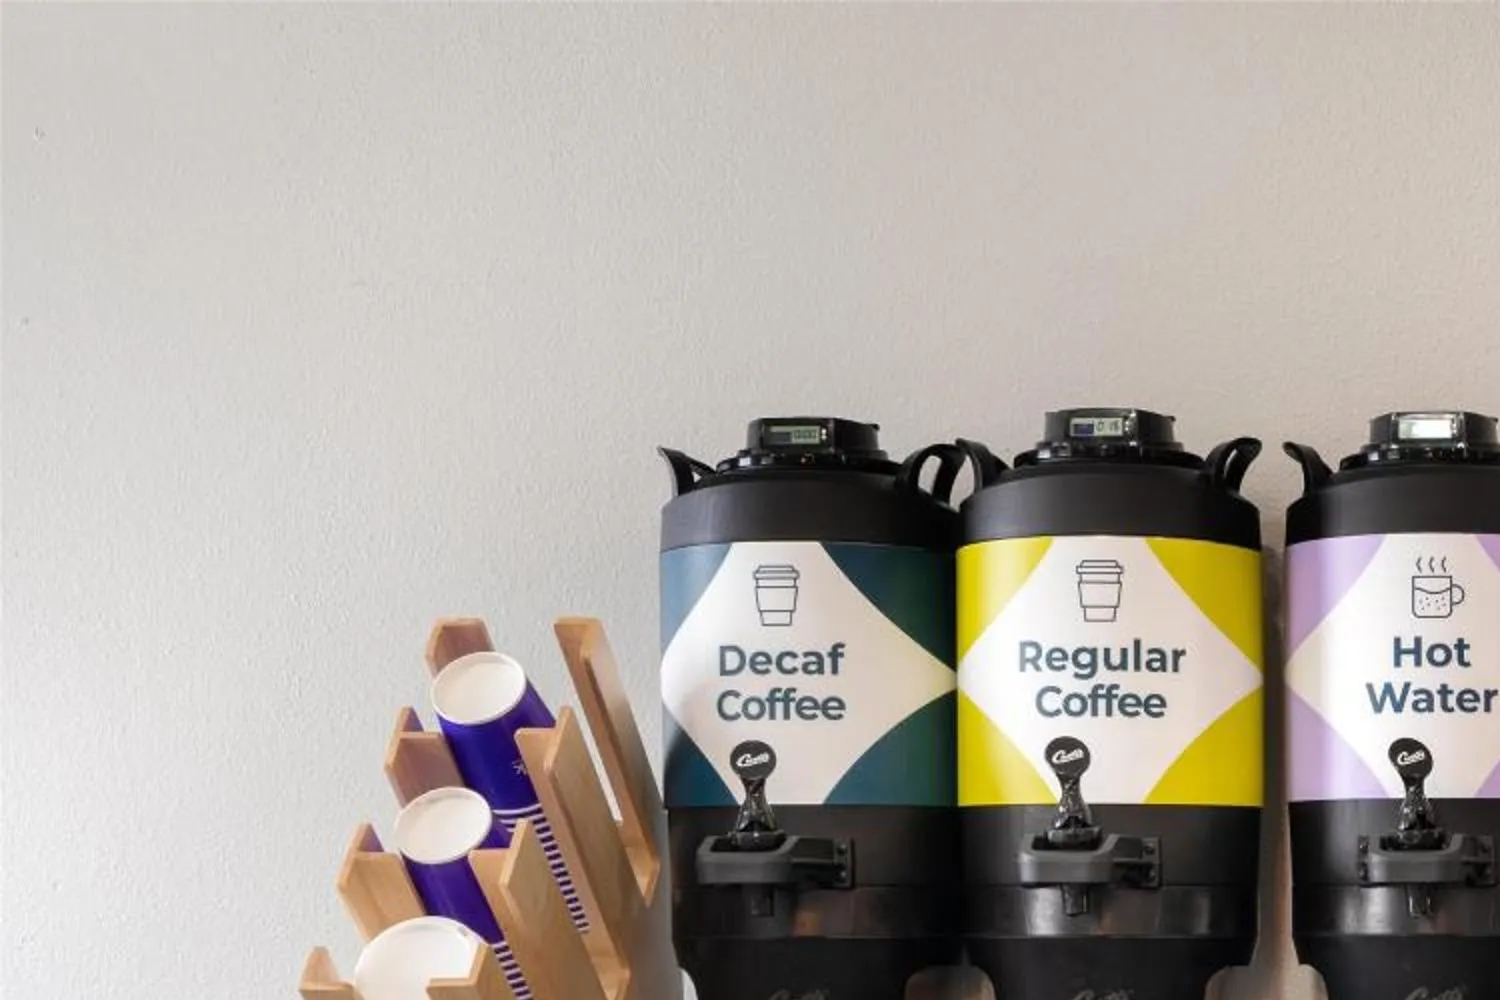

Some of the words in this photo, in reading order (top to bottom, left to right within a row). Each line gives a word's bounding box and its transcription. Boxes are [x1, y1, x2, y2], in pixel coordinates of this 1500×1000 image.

[718, 643, 847, 676] Decaf
[1018, 639, 1187, 680] Regular
[1392, 636, 1472, 668] Hot
[716, 688, 847, 721] Coffee
[1034, 684, 1168, 719] Coffee
[1365, 681, 1500, 714] Water
